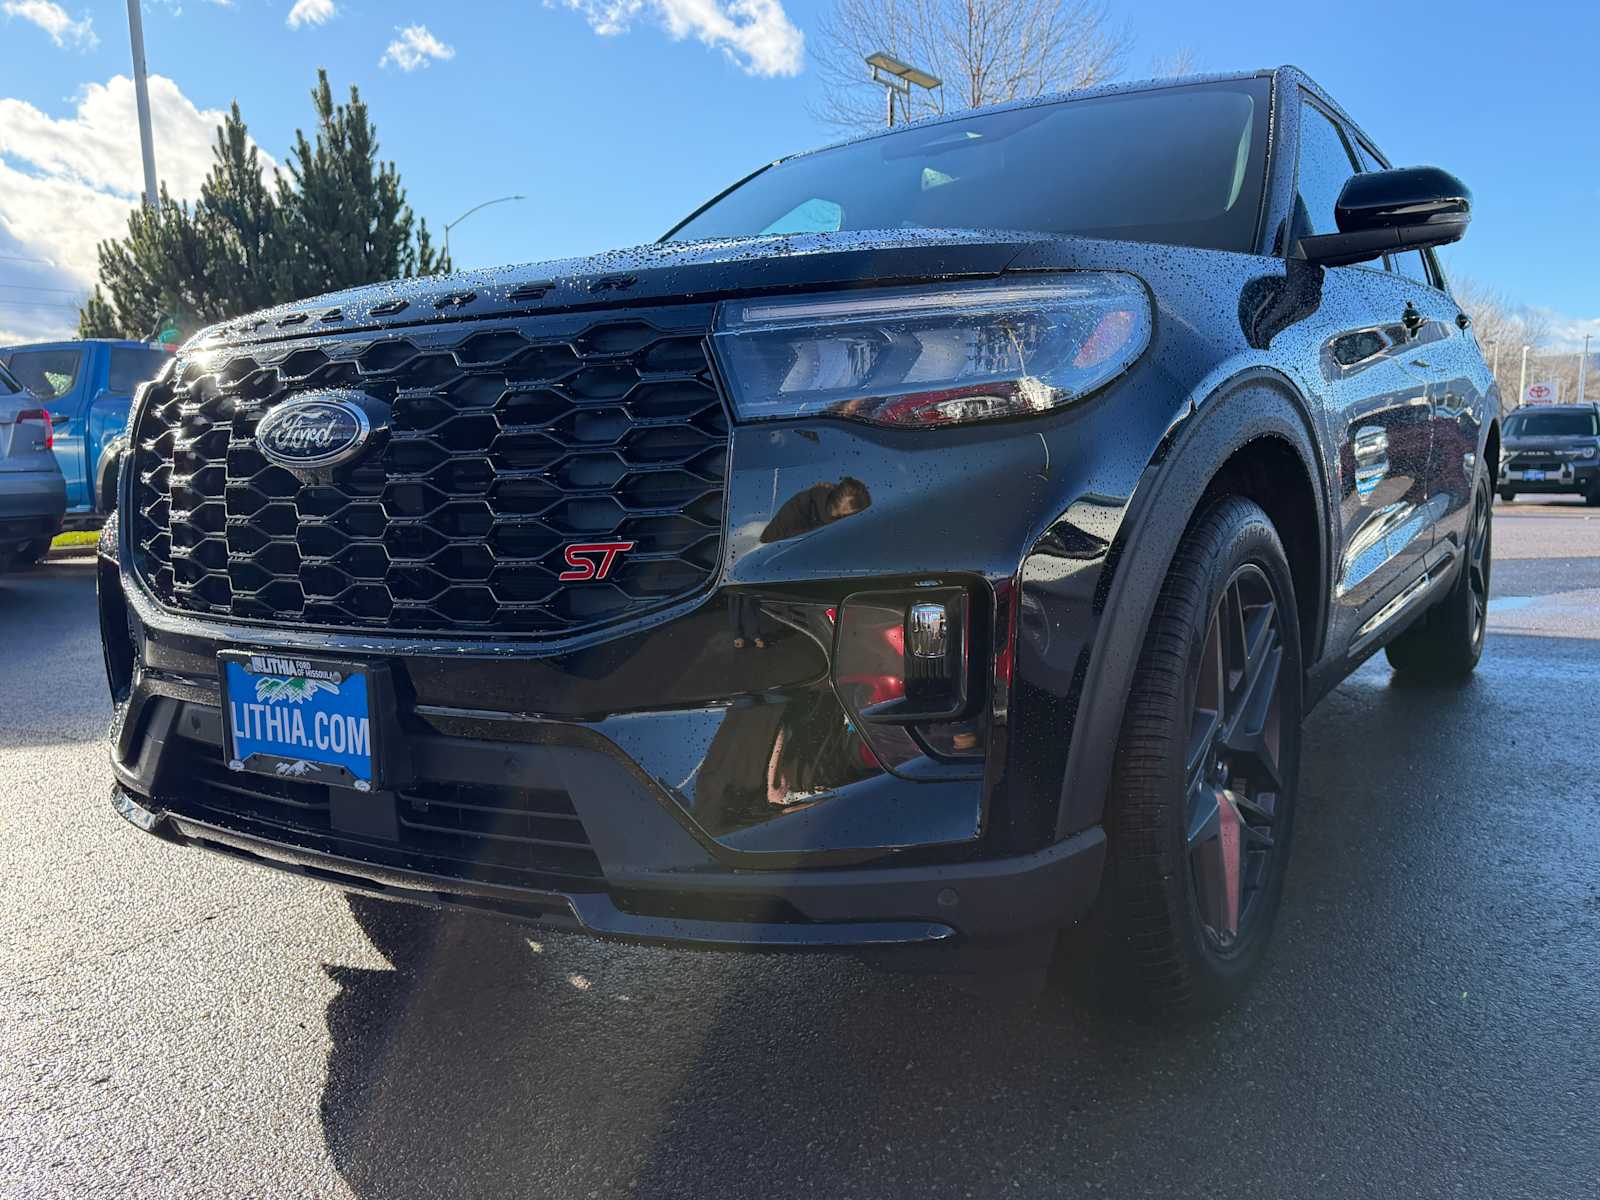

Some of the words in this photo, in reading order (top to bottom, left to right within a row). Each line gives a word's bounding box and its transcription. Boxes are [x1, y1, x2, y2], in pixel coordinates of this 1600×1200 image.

[264, 409, 337, 450] Ford
[559, 541, 634, 580] ST
[263, 656, 297, 676] LITHIA
[296, 660, 311, 670] FORD
[297, 668, 304, 676] OF
[231, 701, 371, 757] LITHIA.COM
